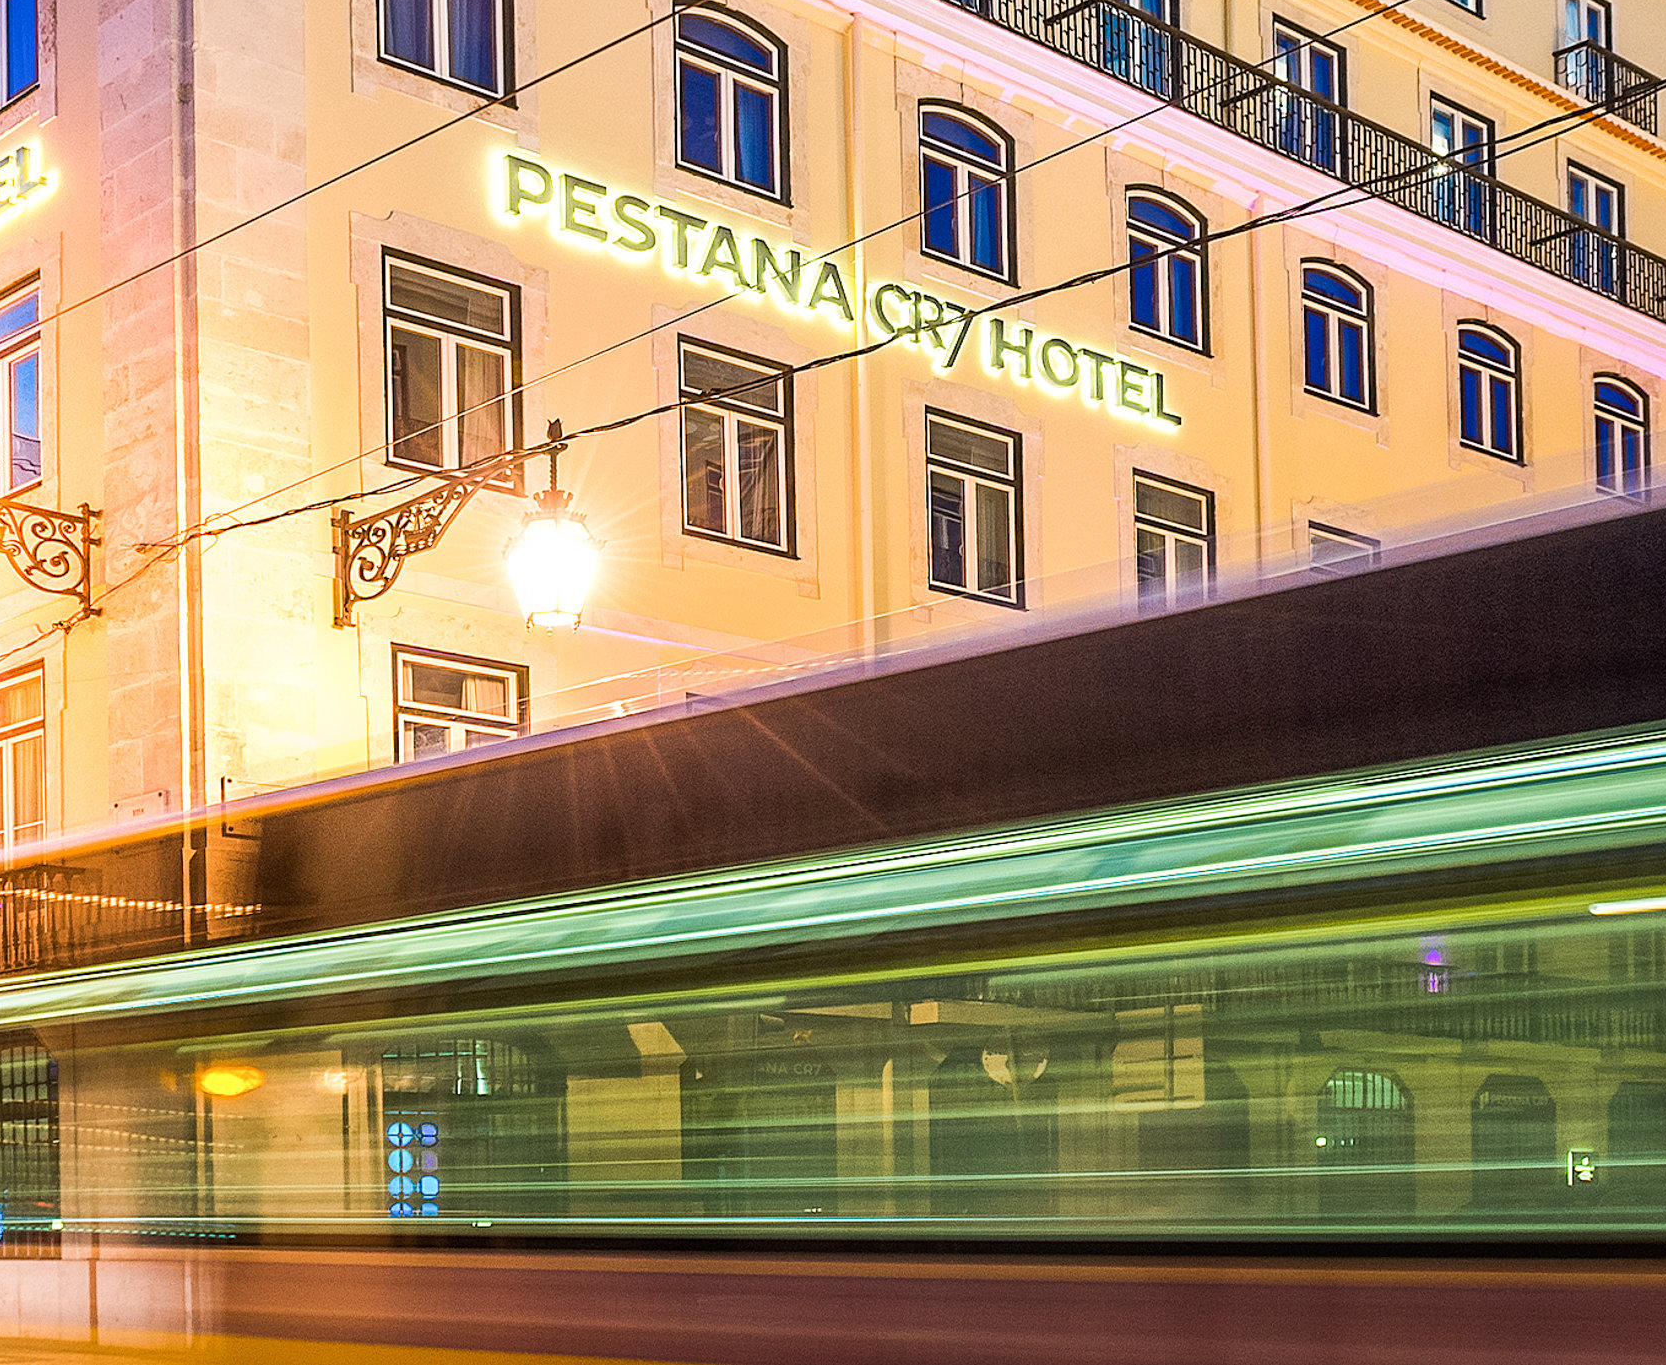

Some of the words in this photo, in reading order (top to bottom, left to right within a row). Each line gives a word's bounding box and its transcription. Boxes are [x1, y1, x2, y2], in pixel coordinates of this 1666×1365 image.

[503, 154, 854, 321] PESTANA
[870, 283, 974, 368] CR7
[990, 318, 1182, 426] HOTEL
